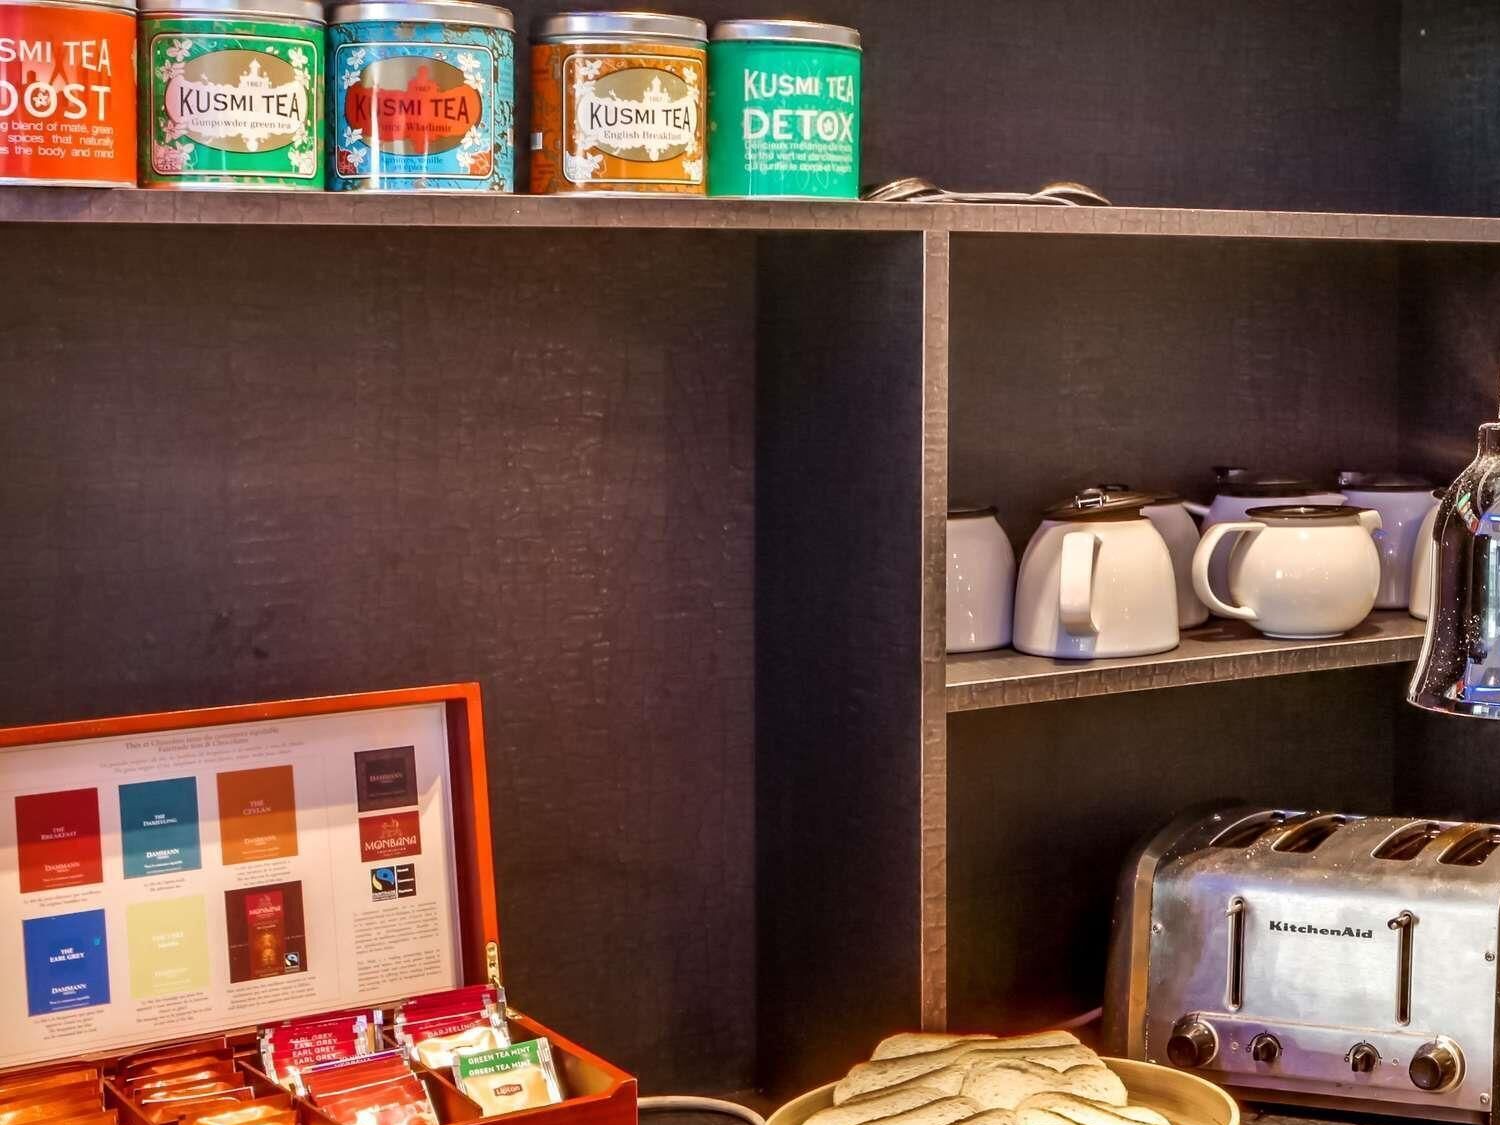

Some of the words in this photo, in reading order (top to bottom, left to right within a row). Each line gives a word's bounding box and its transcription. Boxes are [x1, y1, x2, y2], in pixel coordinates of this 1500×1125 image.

[63, 38, 112, 77] TEA
[744, 68, 818, 102] KUSMI
[826, 75, 854, 106] TEA
[180, 86, 254, 117] KUSMI
[262, 92, 300, 121] TEA
[355, 94, 421, 123] KSMI
[430, 95, 470, 124] TEA
[590, 102, 655, 130] KUSMI
[662, 105, 691, 133] TEA
[743, 108, 854, 143] DETOX
[603, 130, 640, 141] English
[38, 146, 66, 159] body
[364, 835, 417, 851] MONBANA
[1269, 920, 1373, 939] KitchenAid
[314, 1045, 336, 1054] GREY
[468, 1054, 494, 1065] GREEN
[496, 1050, 510, 1059] TEA
[511, 1046, 531, 1055] MINT
[468, 1065, 495, 1076] GREEN
[496, 1062, 511, 1072] TEA
